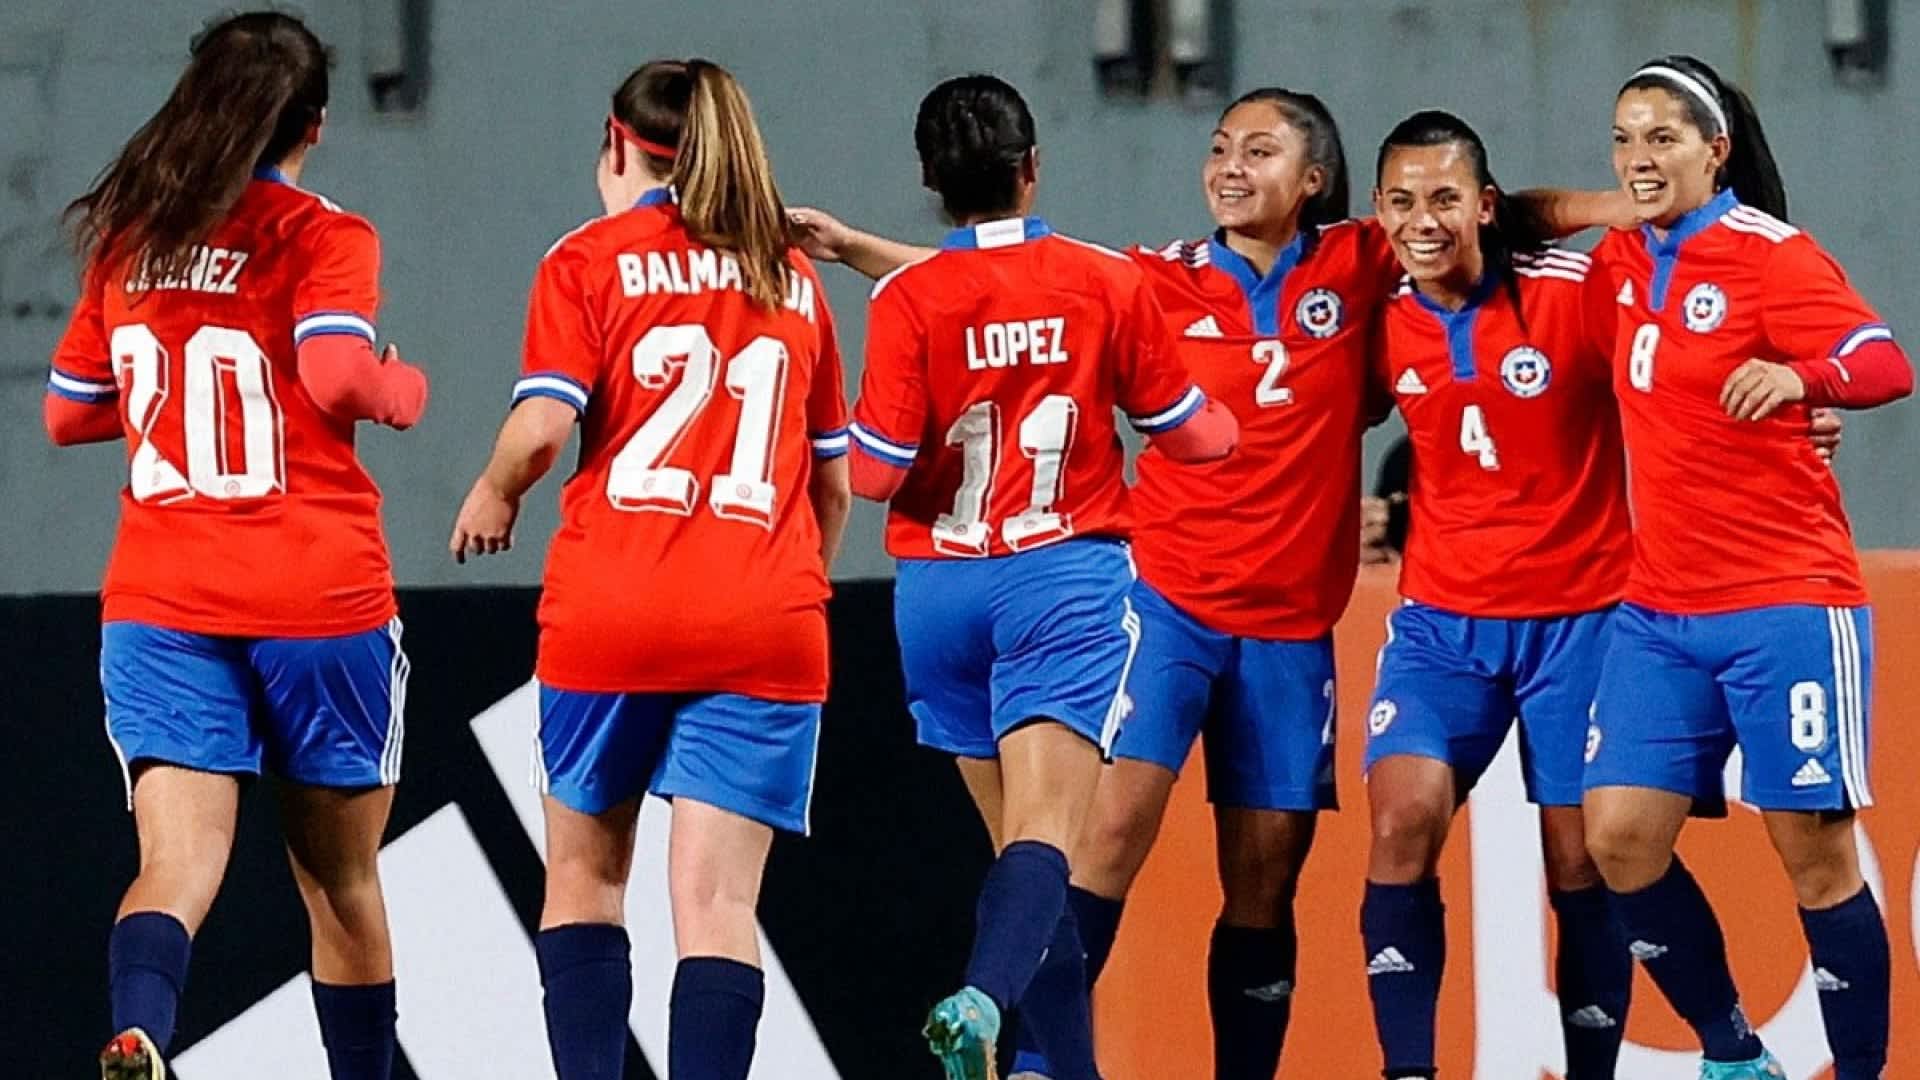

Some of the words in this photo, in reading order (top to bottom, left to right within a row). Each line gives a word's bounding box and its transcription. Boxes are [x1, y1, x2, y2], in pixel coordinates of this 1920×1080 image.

[617, 248, 815, 325] BALMADA
[965, 316, 1069, 371] LOPEZ
[1252, 340, 1294, 407] 2
[1629, 323, 1661, 393] 8
[111, 323, 287, 505] 20
[606, 324, 789, 532] 21
[1461, 405, 1501, 471] 4
[931, 394, 1079, 557] 11
[1790, 681, 1828, 751] 8
